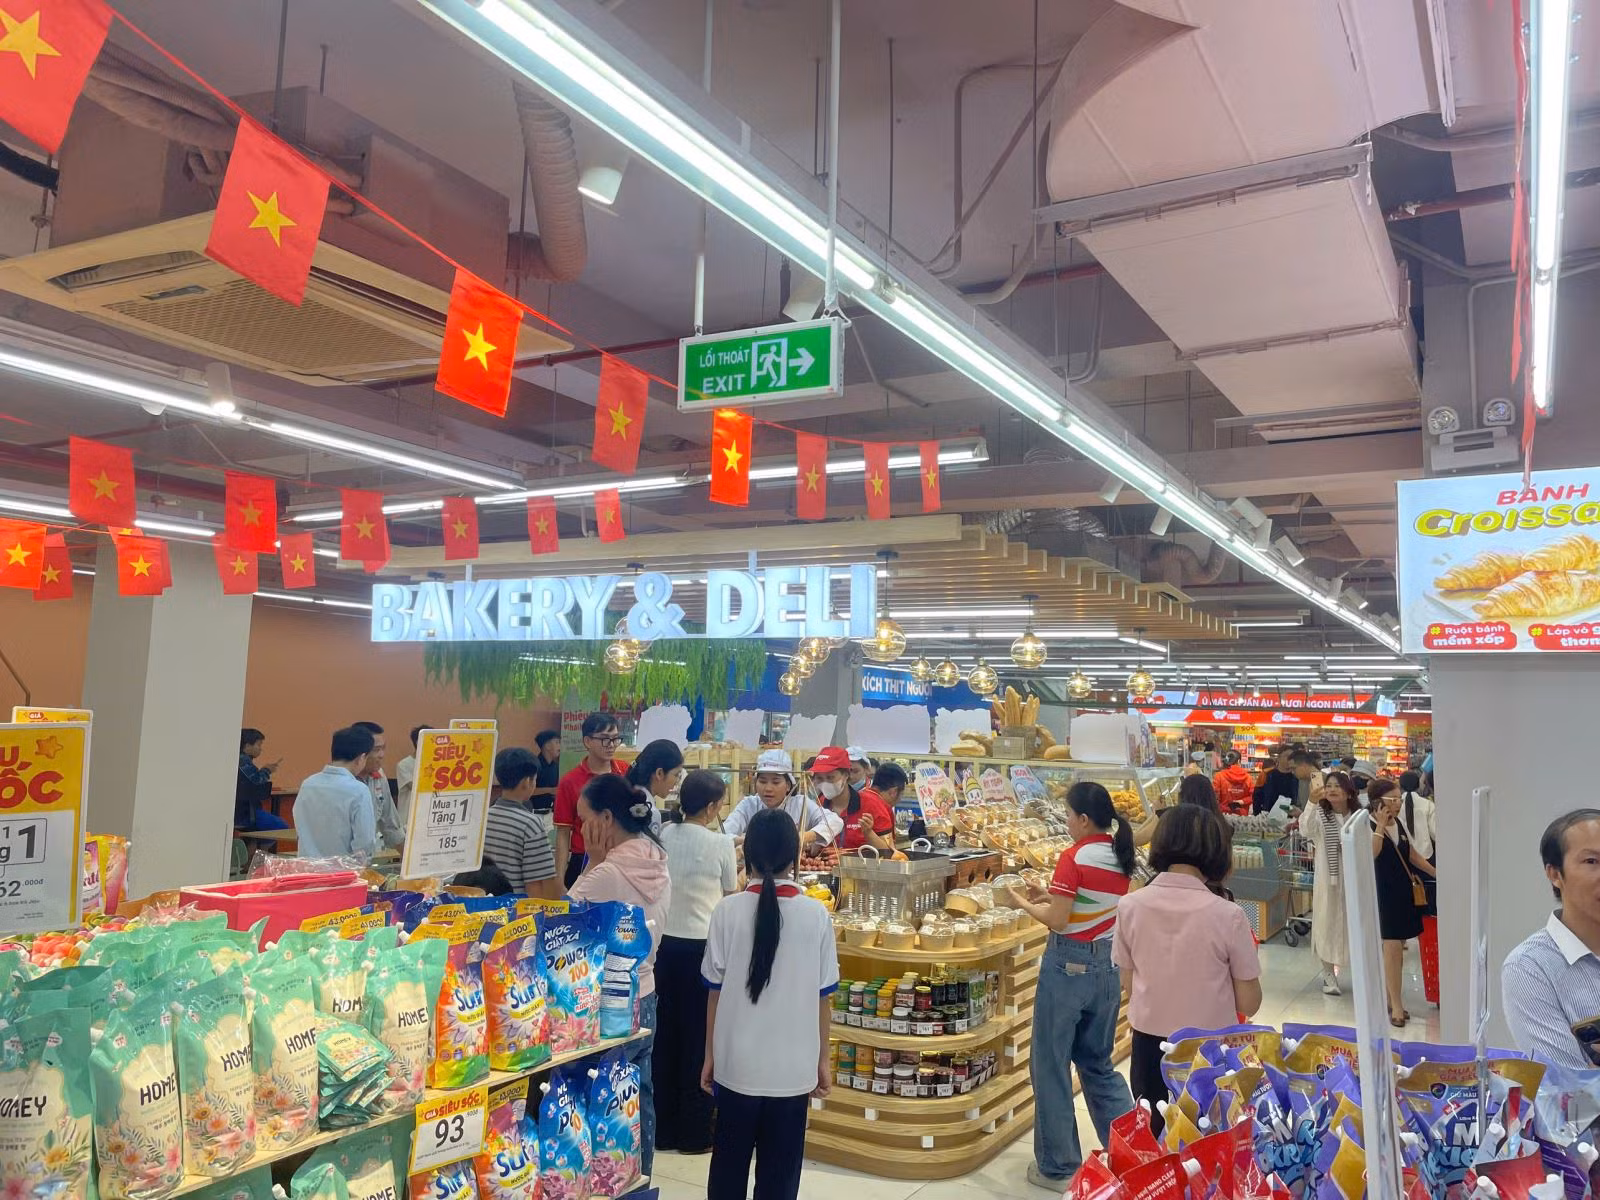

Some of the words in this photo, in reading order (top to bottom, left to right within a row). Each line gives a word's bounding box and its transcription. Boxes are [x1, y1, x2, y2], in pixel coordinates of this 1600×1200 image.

[700, 347, 716, 369] LỐI
[718, 346, 750, 365] THOÁT
[703, 373, 746, 394] EXIT
[1496, 482, 1590, 505] BÁNH
[371, 574, 622, 641] BAKERY
[627, 572, 687, 639] &
[706, 564, 877, 639] DELI
[1432, 632, 1472, 646] mềm
[1475, 631, 1505, 647] xốp
[1445, 624, 1473, 636] Ruột
[1475, 624, 1505, 634] bánh
[885, 678, 905, 698] THỊT
[433, 742, 466, 761] SIÊU
[433, 755, 483, 790] SỐC
[432, 799, 450, 809] Mua
[458, 799, 469, 822] 1
[431, 811, 456, 825] Tặng
[18, 825, 36, 859] 1
[438, 836, 457, 849] 185
[544, 924, 571, 940] NƯỚC
[546, 944, 593, 972] Power
[568, 961, 589, 983] 100
[398, 1006, 429, 1028] HOME
[438, 1099, 460, 1117] SIÊU
[461, 1090, 480, 1108] SỐC
[435, 1114, 465, 1148] 93
